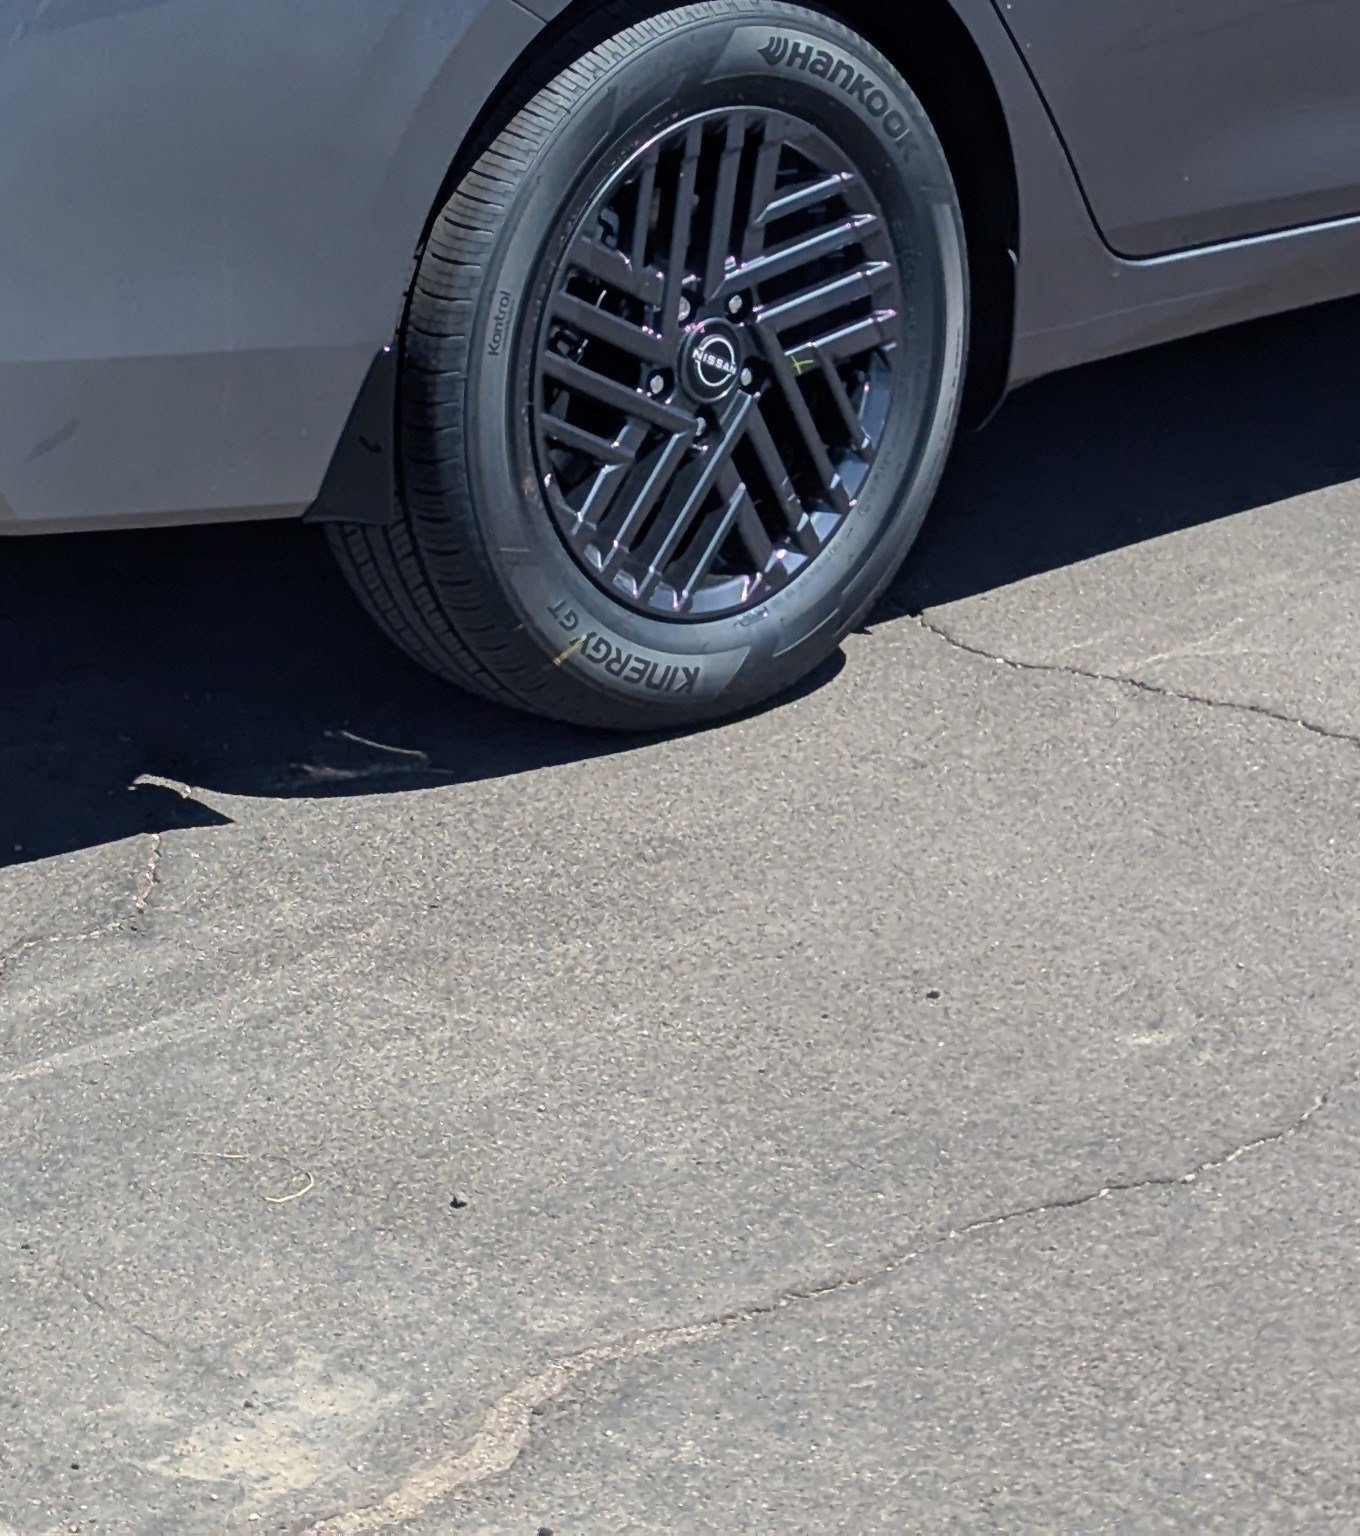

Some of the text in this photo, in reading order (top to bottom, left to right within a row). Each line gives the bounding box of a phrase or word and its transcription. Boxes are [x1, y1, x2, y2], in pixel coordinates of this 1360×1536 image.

[487, 290, 512, 356] Kontrol
[692, 349, 737, 375] NISSAN
[547, 599, 579, 631] GT
